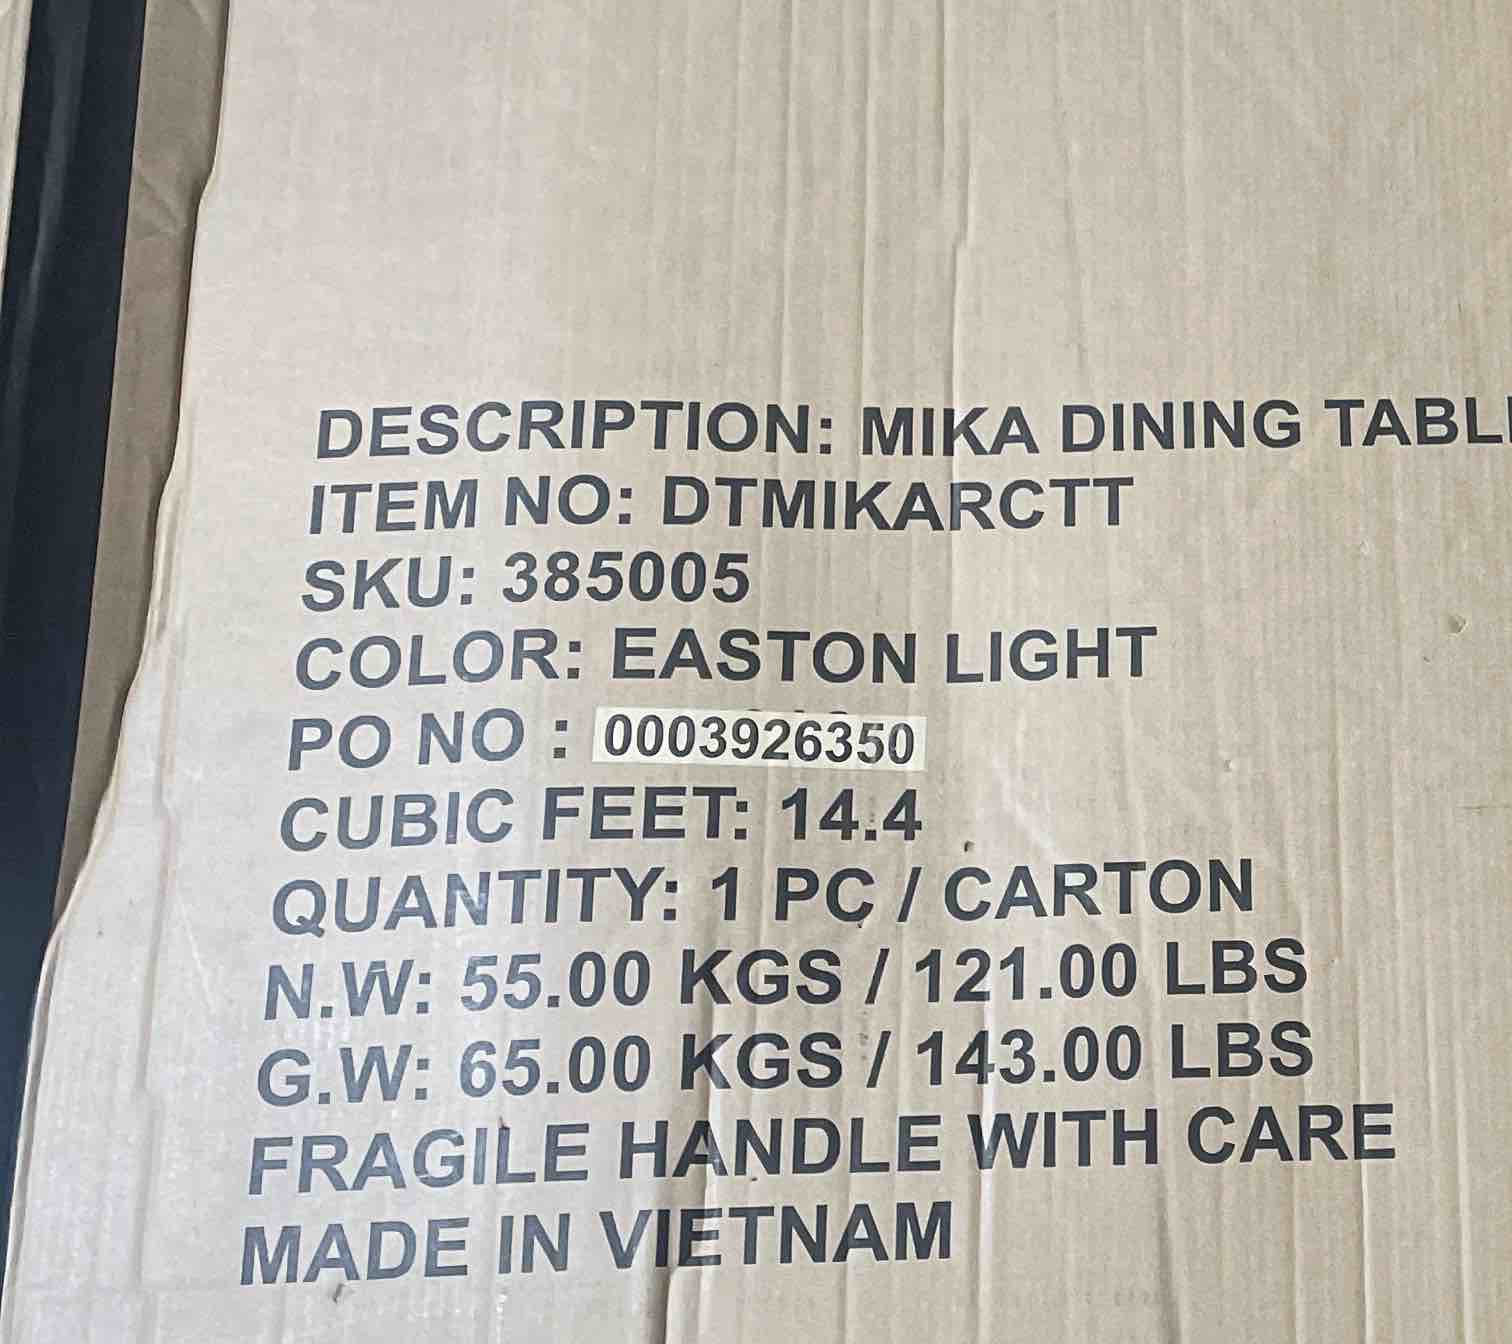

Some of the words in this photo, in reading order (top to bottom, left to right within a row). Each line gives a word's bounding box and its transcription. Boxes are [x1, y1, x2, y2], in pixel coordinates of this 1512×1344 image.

[316, 399, 833, 460] DESCRIPTION:
[862, 404, 1039, 457] MIKA
[1062, 398, 1302, 453] DINING
[309, 478, 479, 536] ITEM
[504, 473, 633, 529] NO:
[662, 476, 1134, 532] DTMIKARCTT
[301, 554, 475, 613] SKU:
[502, 550, 750, 604] 385005
[295, 628, 581, 691] COLOR:
[612, 626, 917, 684] EASTON
[946, 626, 1158, 684] LIGHT
[287, 715, 392, 772] PO
[417, 707, 525, 766] NO
[602, 713, 915, 765] 0003926350
[279, 786, 514, 853] CUBIC
[542, 785, 750, 841] FEET:
[781, 787, 923, 842] 14.4
[272, 866, 679, 938] QUANTITY:
[710, 866, 739, 922] 1
[774, 866, 875, 923] PC
[897, 866, 922, 923] /
[944, 857, 1254, 921] CARTON
[263, 959, 433, 1021] N.W:
[460, 949, 651, 1012] 55.00
[679, 947, 842, 1007] KGS
[866, 947, 890, 1005] /
[914, 942, 1138, 1003] 121.00
[1165, 937, 1307, 997] LBS
[257, 1042, 430, 1106] G.W:
[459, 1033, 652, 1096] 65.00
[679, 1031, 843, 1091] KGS
[866, 1030, 892, 1089] /
[916, 1024, 1143, 1086] 143.00
[1170, 1020, 1314, 1079] LBS
[247, 1122, 590, 1196] FRAGILE
[619, 1115, 943, 1181] HANDLE
[967, 1107, 1159, 1170] WITH
[1187, 1102, 1396, 1164] CARE
[240, 1216, 472, 1286] MADE
[498, 1211, 571, 1275] IN
[599, 1200, 953, 1270] VIETNAM
